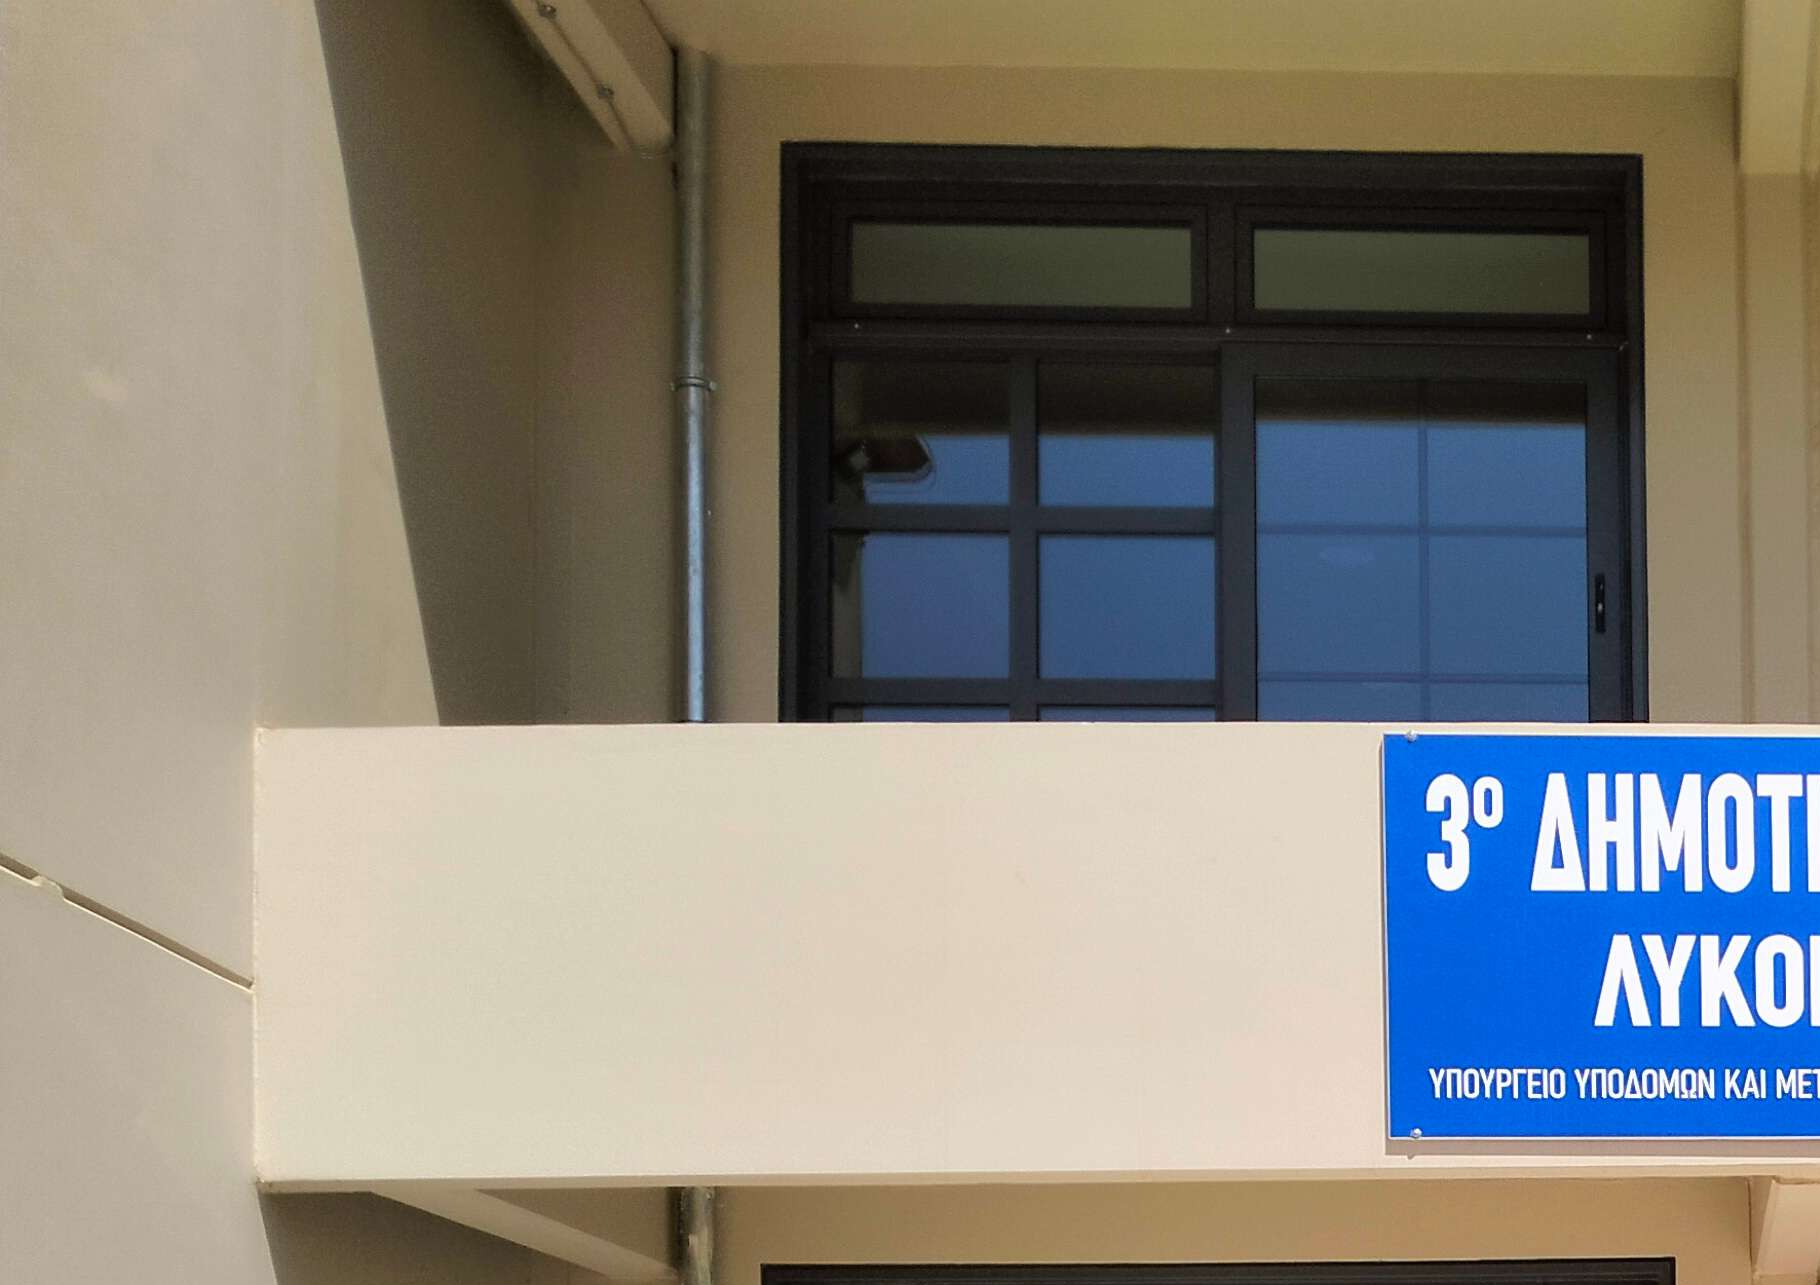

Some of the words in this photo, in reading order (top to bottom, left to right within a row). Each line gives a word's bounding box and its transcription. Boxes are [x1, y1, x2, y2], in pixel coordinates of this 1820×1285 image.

[1429, 1067, 1566, 1099] ΥΠΟΥΡΓΕΙΟ
[1574, 1068, 1715, 1099] ΥΠΟΔΟΜΩΝ
[1725, 1068, 1767, 1099] ΚΑΙ
